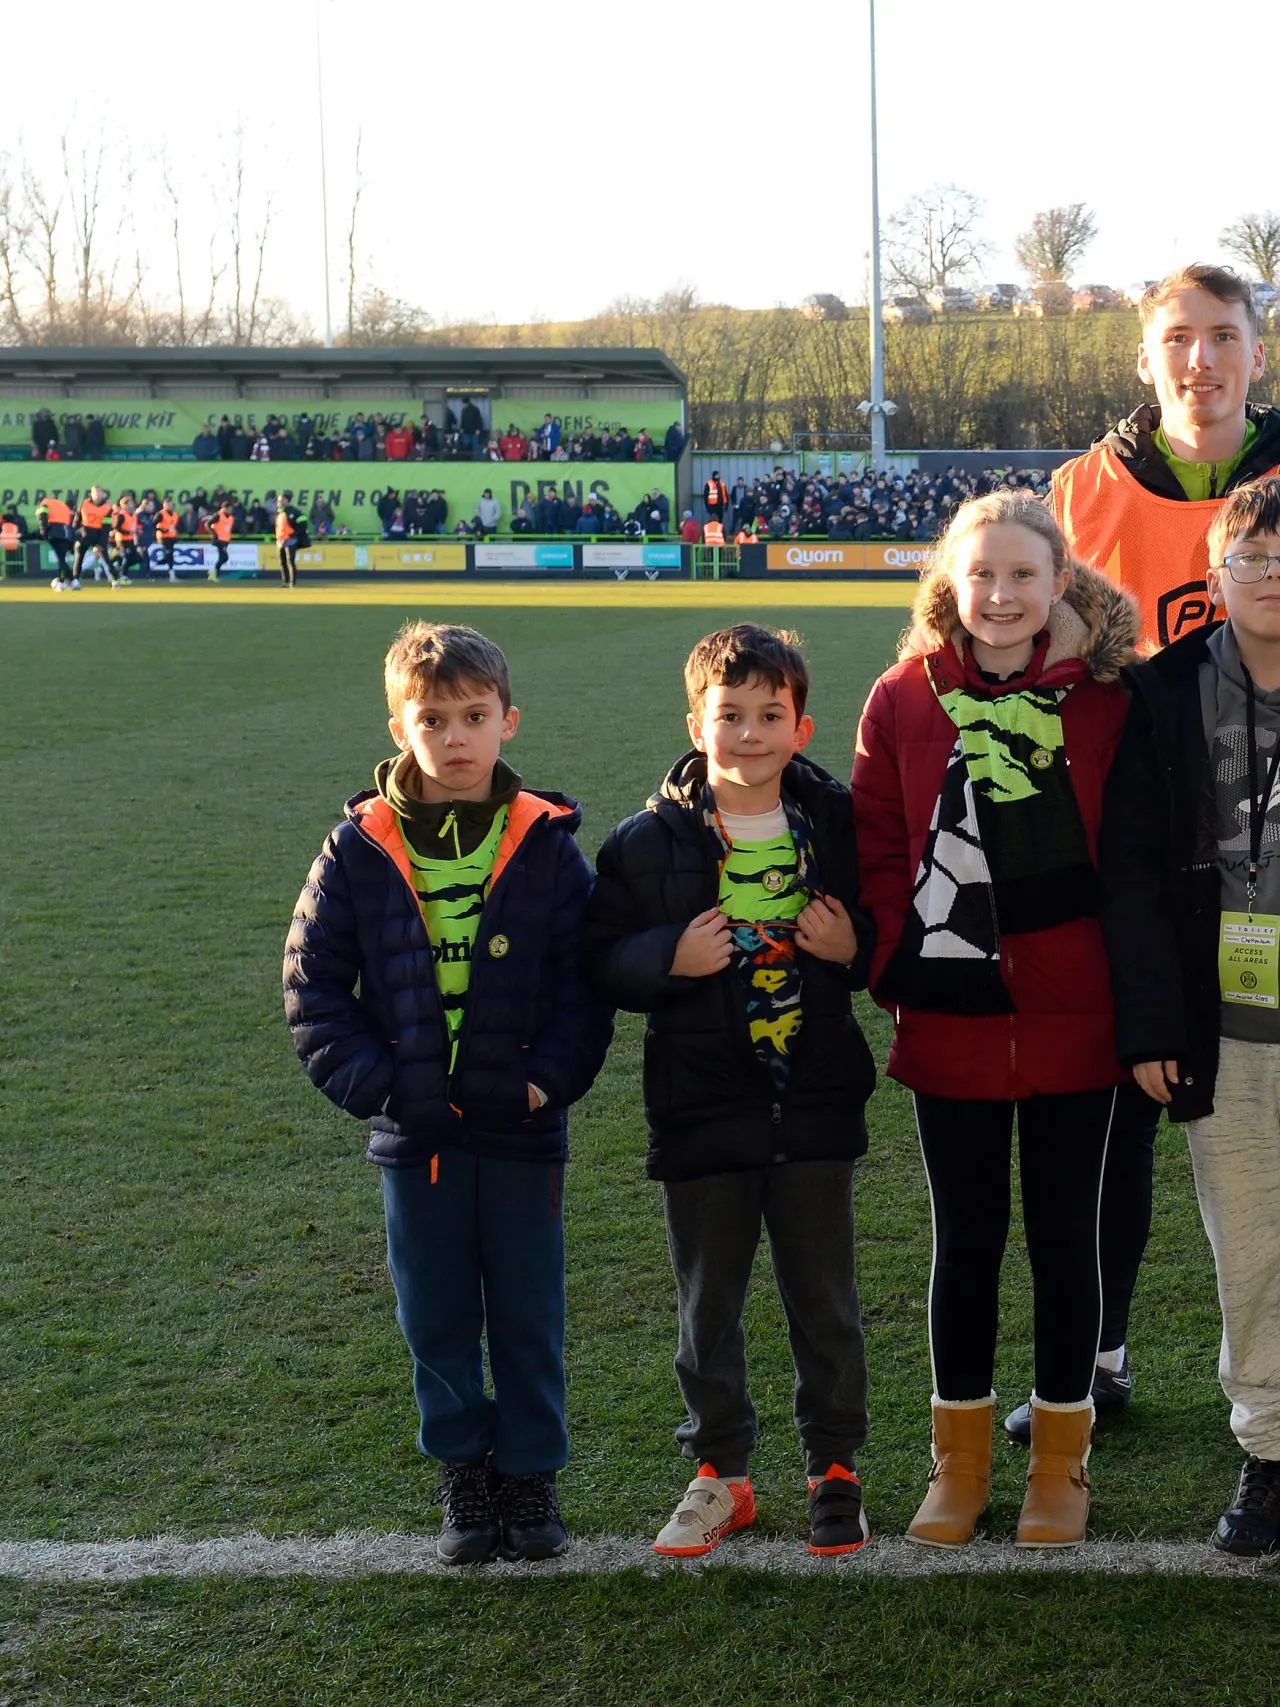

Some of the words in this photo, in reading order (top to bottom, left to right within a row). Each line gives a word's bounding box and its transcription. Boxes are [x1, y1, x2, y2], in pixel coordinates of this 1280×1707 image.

[786, 547, 844, 567] Quorn
[1233, 947, 1264, 956] ACCESS
[1228, 955, 1242, 963] ALL
[1242, 956, 1269, 965] AREAS
